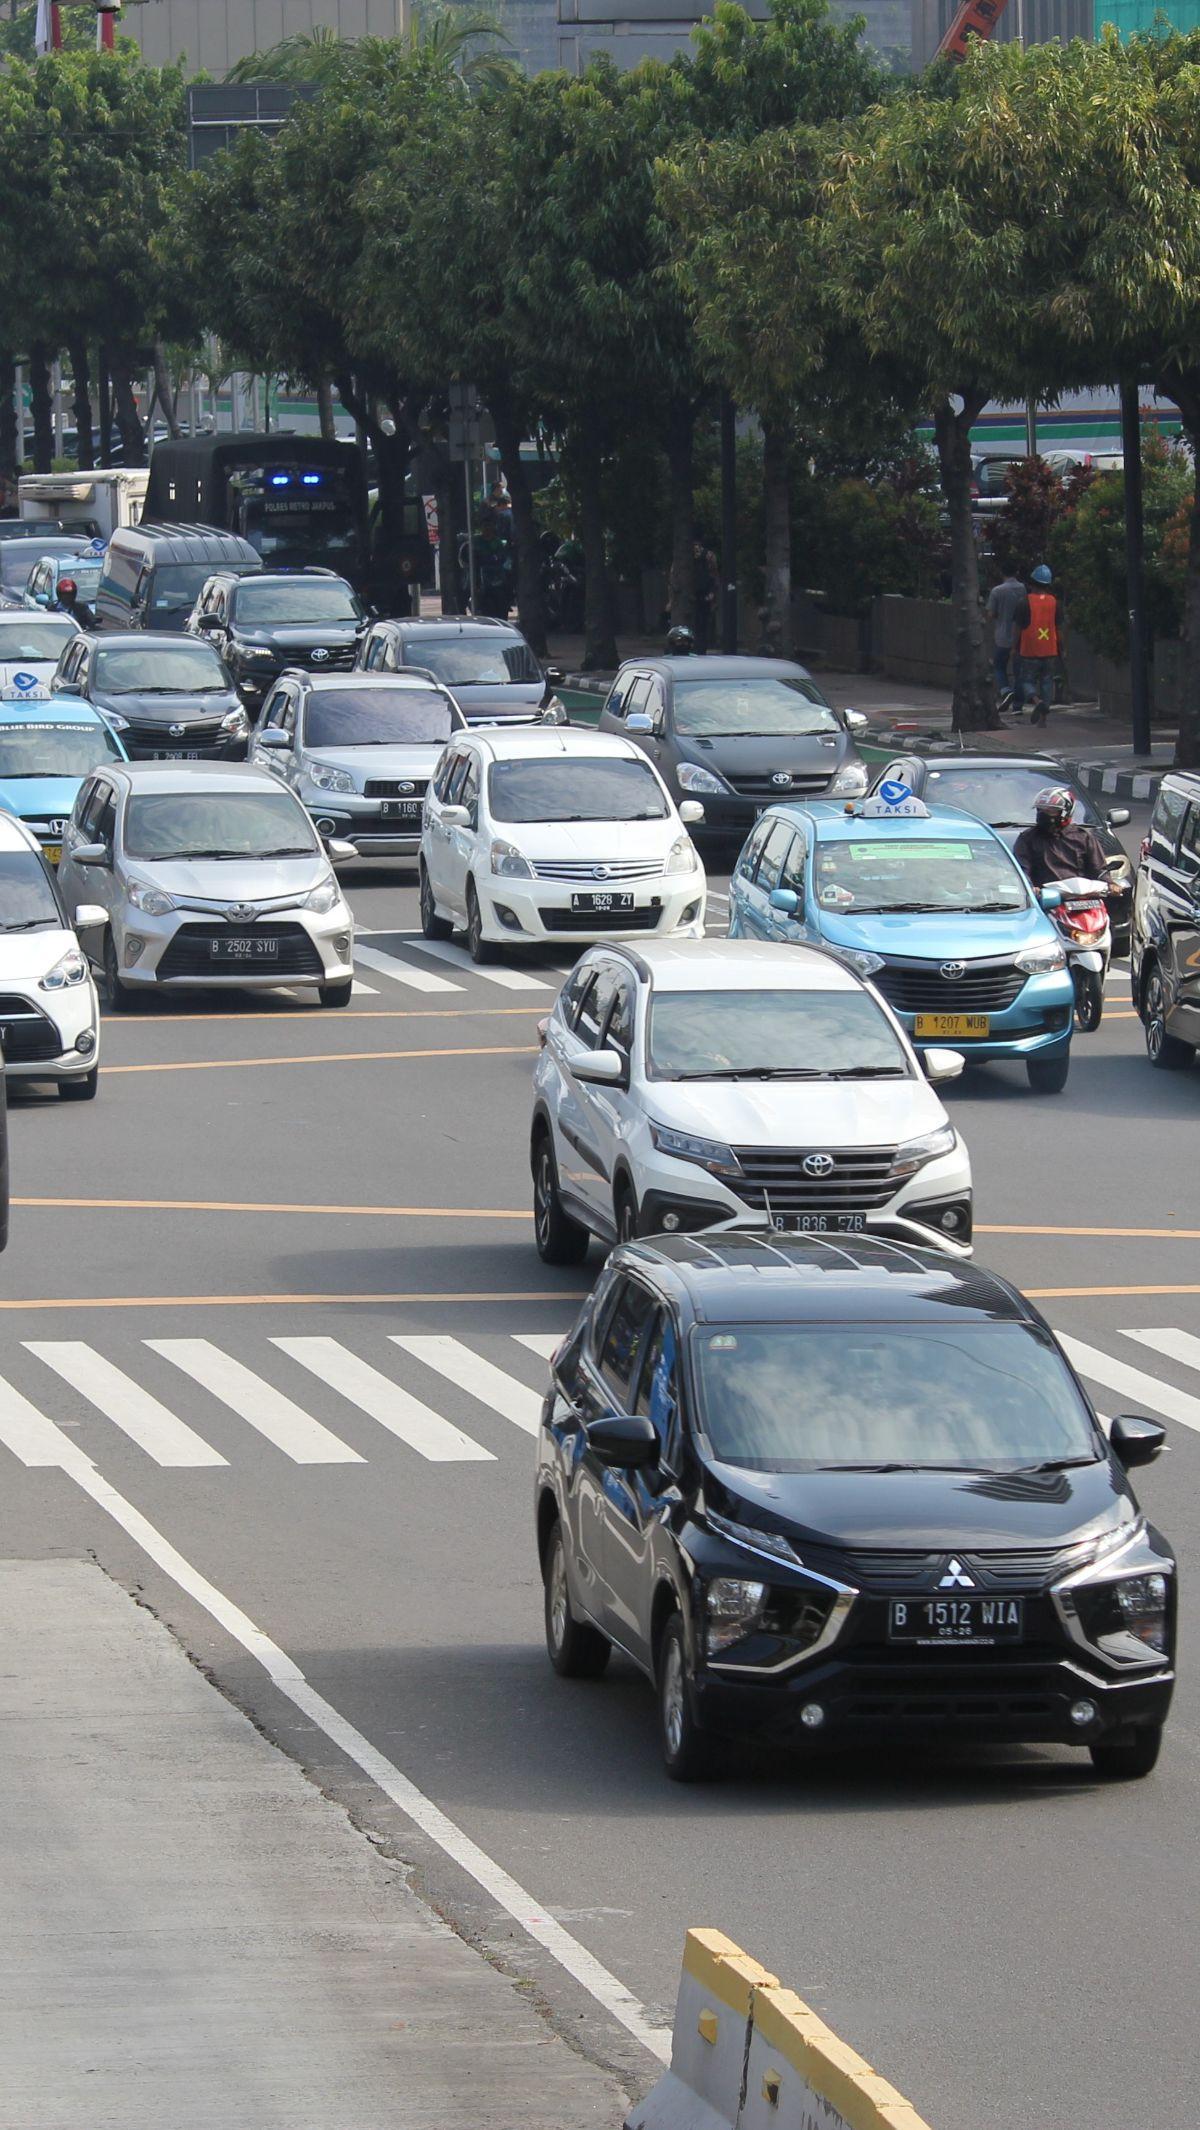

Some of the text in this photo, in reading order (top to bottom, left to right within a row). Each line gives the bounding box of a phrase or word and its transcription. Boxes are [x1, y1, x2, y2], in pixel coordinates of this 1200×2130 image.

[0, 724, 25, 732] BLUE
[56, 724, 95, 732] GROUP
[383, 802, 389, 813] B
[875, 805, 917, 814] TAKSI
[573, 893, 632, 906] A 1628 ZY
[212, 940, 276, 953] B 2502 SYU
[917, 1016, 987, 1029] B 1207 WUB
[796, 1216, 828, 1231] 1836
[895, 1602, 1019, 1626] B 1512 WIA
